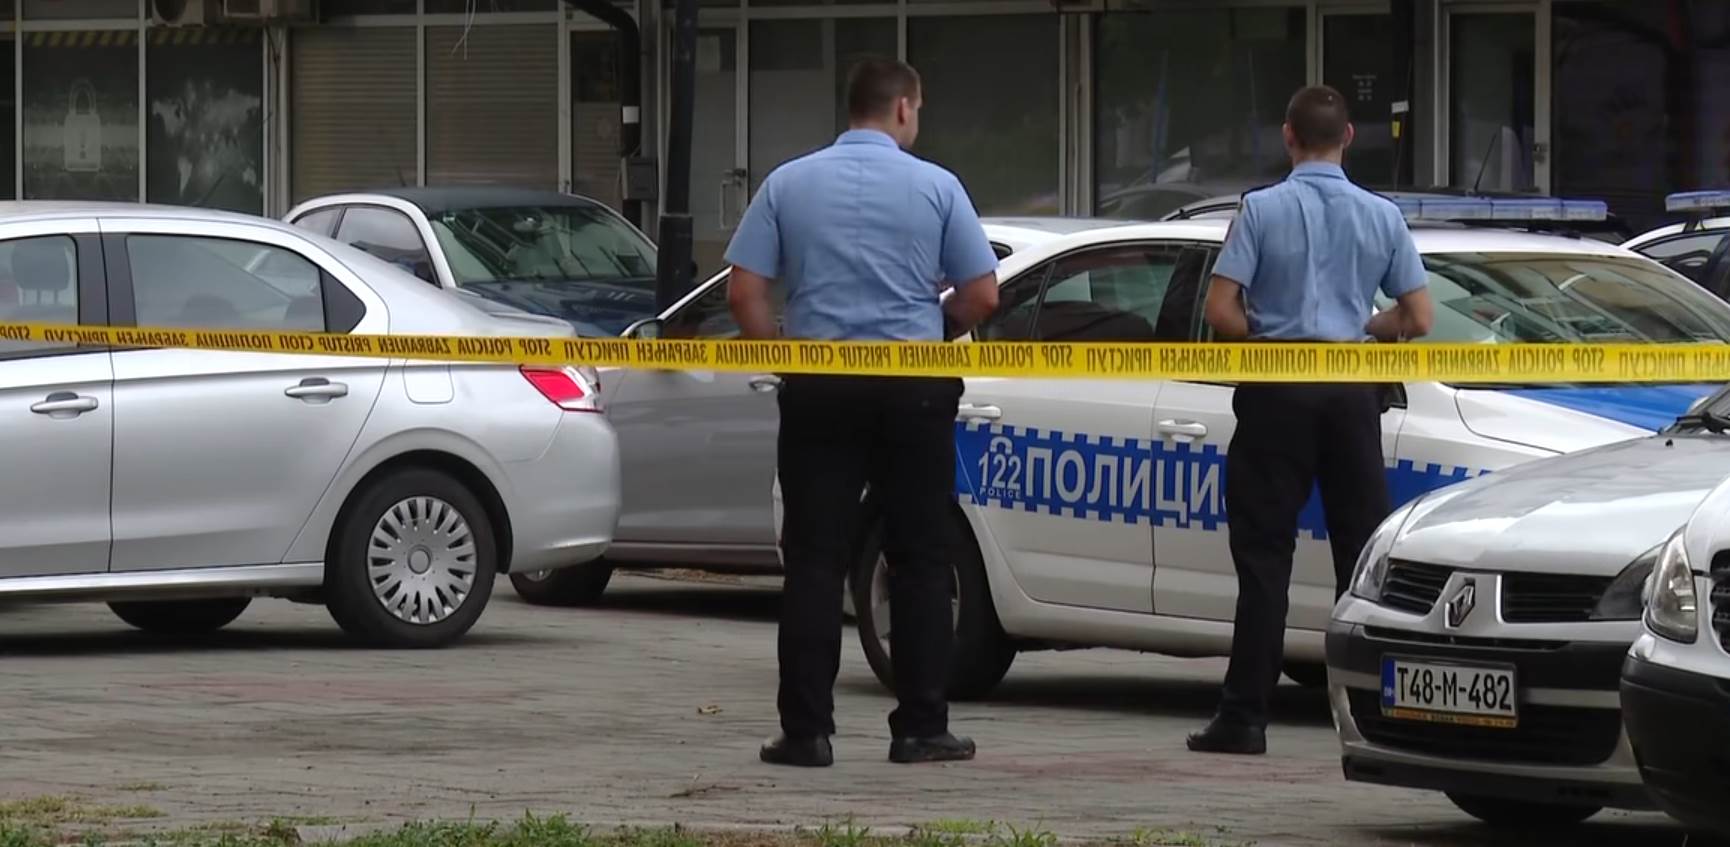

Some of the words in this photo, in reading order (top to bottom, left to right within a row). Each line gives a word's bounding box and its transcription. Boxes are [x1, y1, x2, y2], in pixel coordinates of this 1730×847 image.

[978, 452, 1021, 489] 122
[1025, 446, 1227, 523] ПОЛИЦИ
[979, 487, 1021, 499] POLICE
[1397, 667, 1512, 711] T48-M-482
